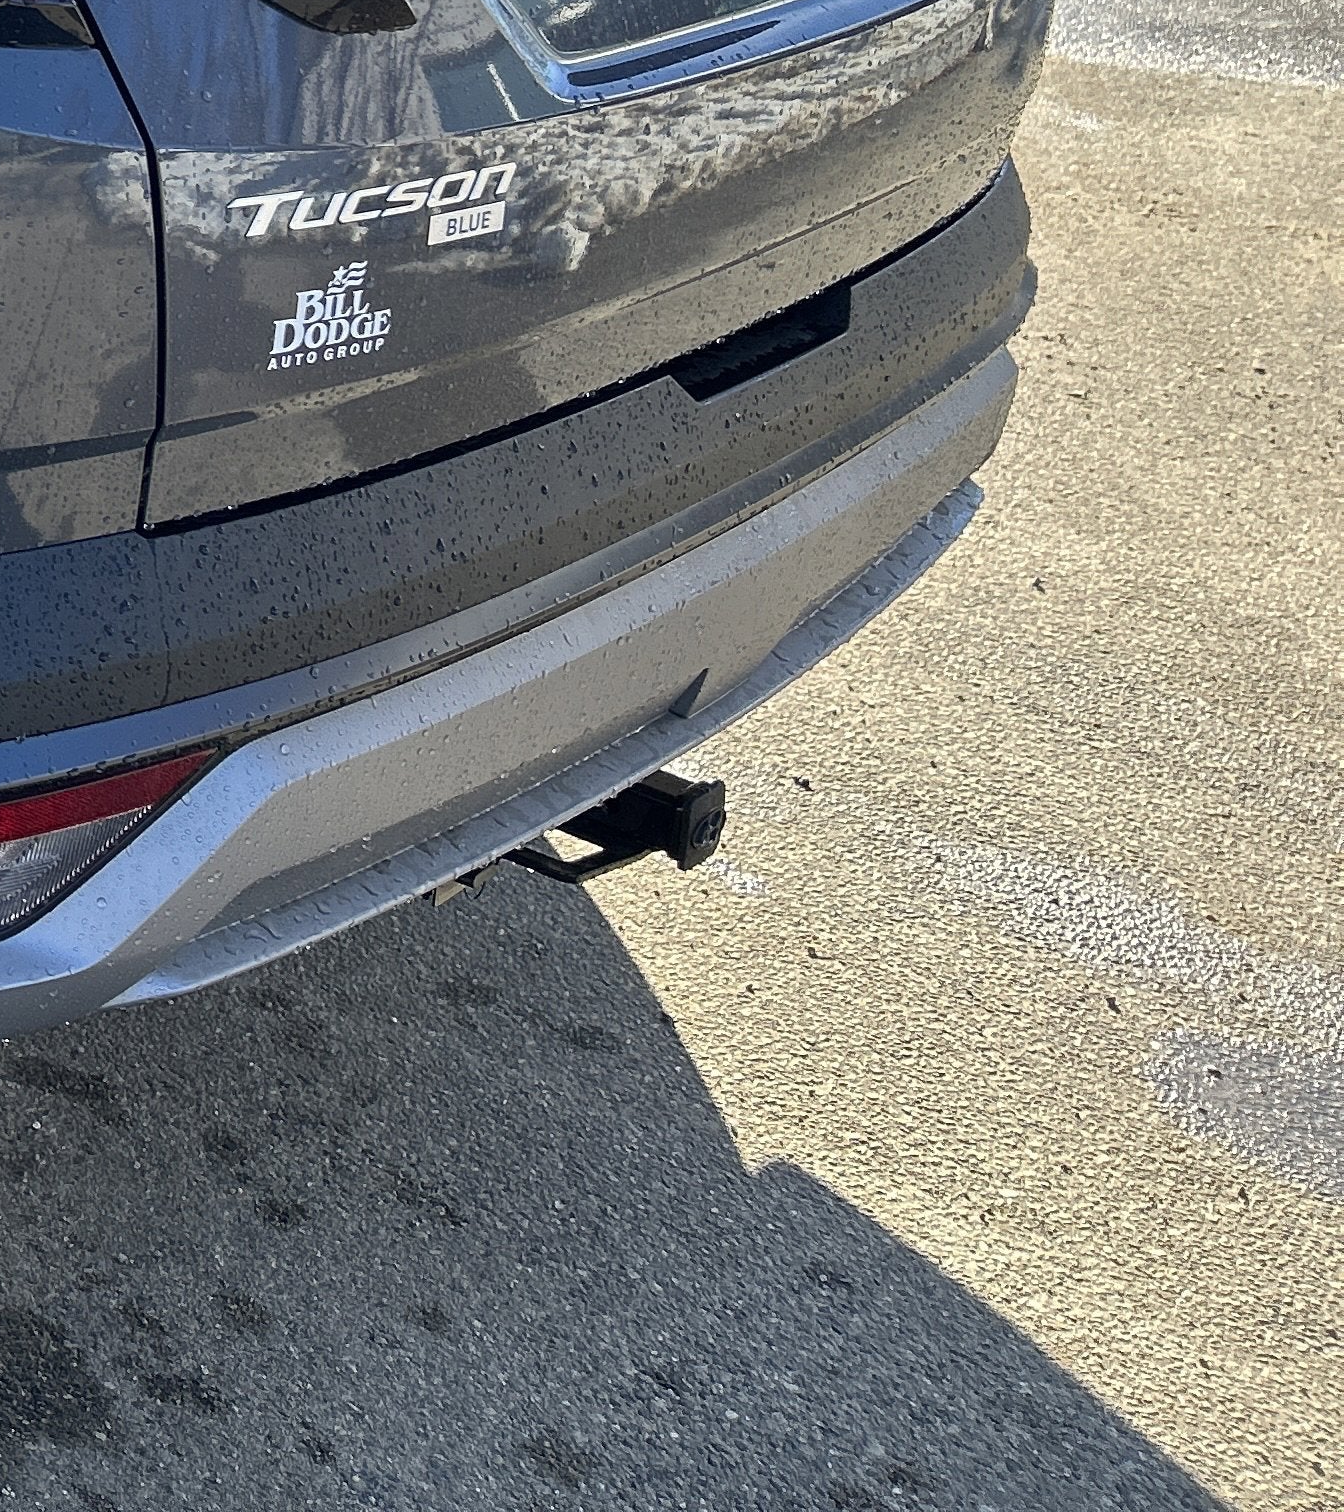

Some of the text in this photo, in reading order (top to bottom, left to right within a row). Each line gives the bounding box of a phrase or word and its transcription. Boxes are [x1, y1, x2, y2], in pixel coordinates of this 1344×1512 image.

[445, 211, 493, 238] BLUE
[295, 289, 372, 325] BILL
[269, 308, 392, 356] DODGE
[266, 337, 385, 371] AUTO GROUP
